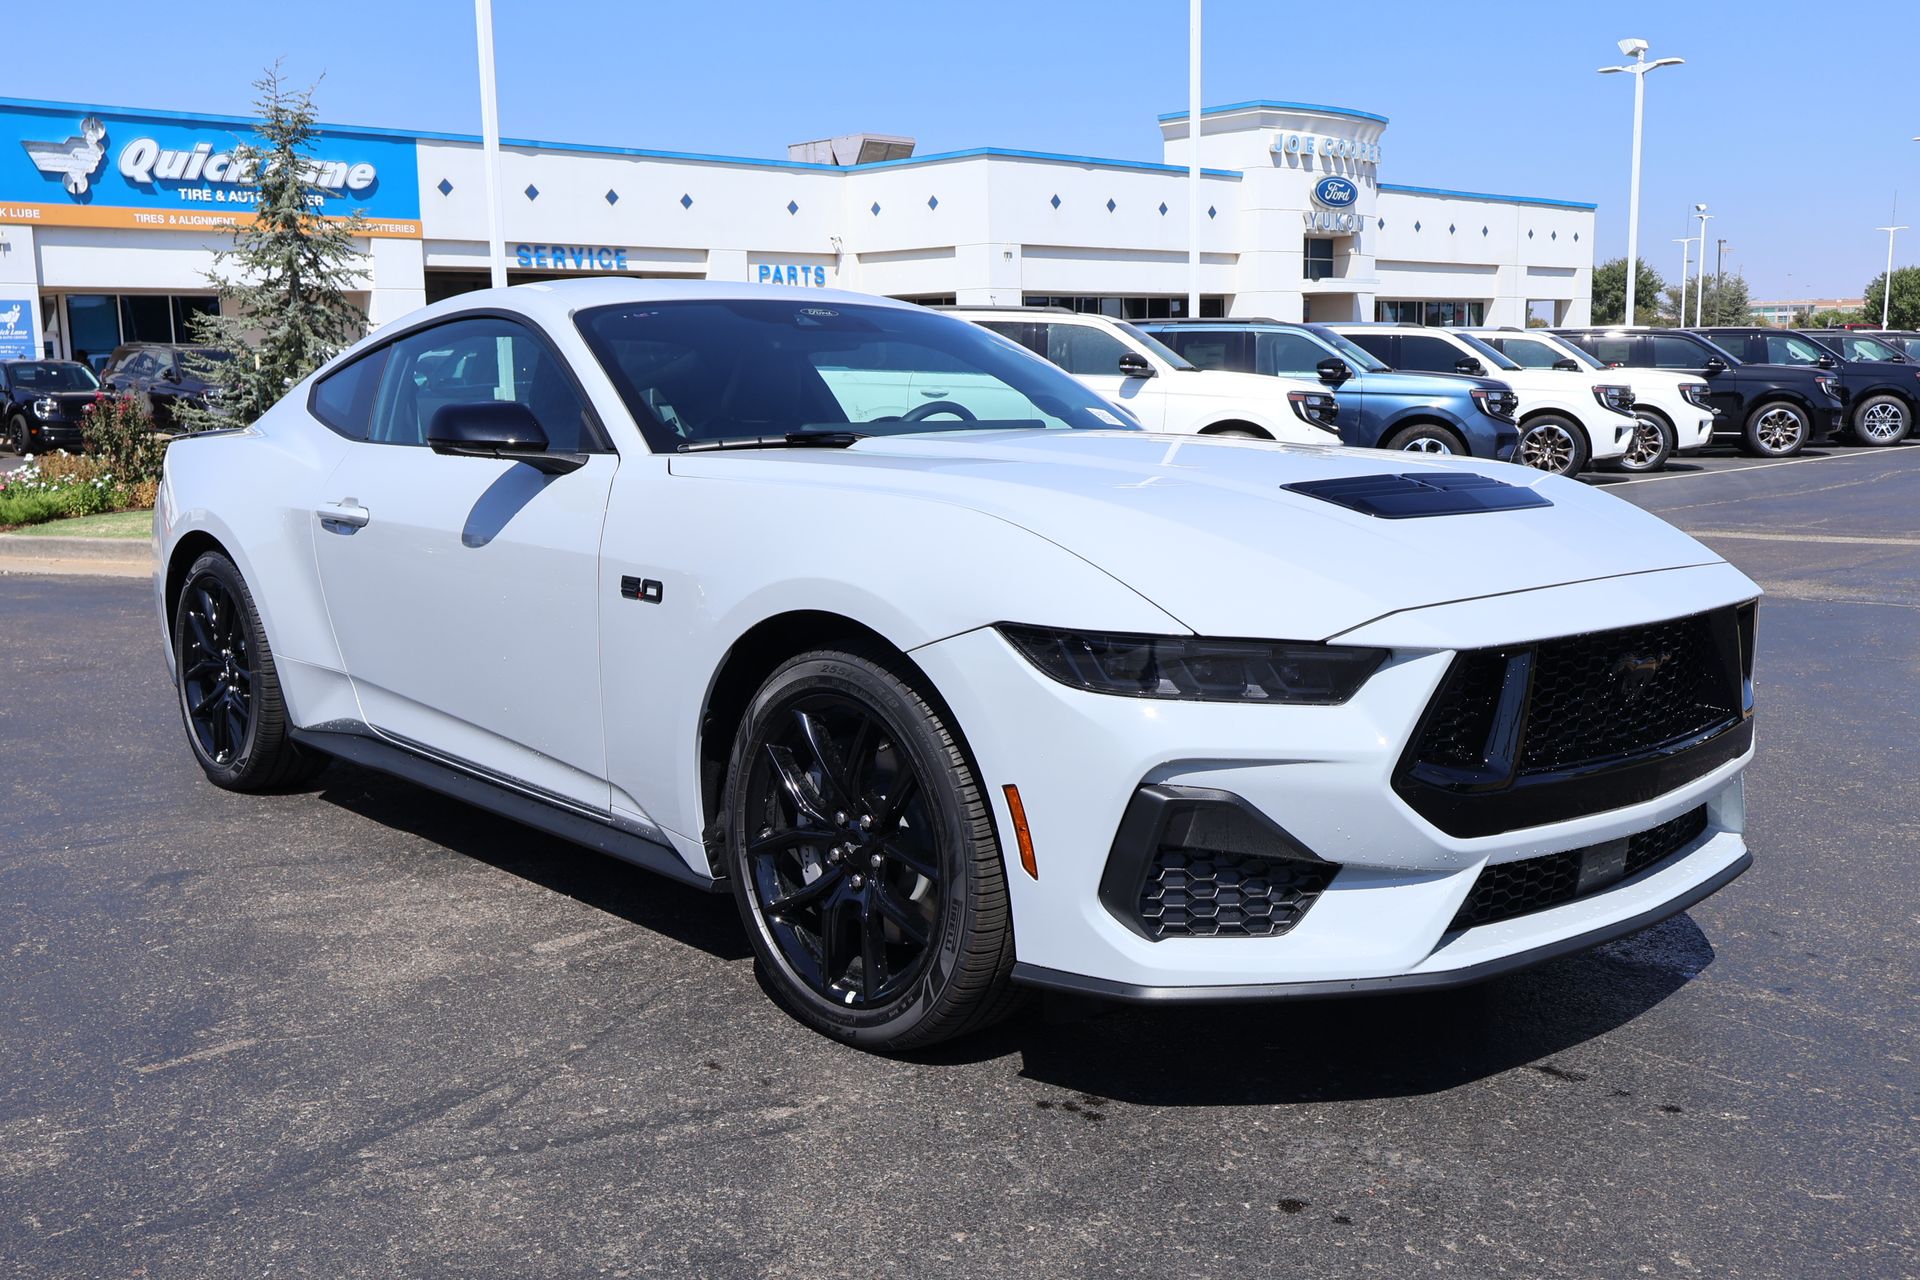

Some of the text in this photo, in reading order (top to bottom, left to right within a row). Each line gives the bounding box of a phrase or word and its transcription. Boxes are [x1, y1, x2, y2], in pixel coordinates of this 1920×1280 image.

[1270, 133, 1315, 155] JOE
[178, 188, 212, 202] TIRE
[216, 191, 226, 202] &
[1324, 181, 1351, 201] Ford
[10, 207, 41, 219] LUBE
[134, 213, 237, 226] TIRES & ALIGNMENT
[1304, 212, 1364, 232] YUKON
[516, 245, 628, 270] SERVICE
[758, 264, 826, 287] PARTS
[621, 575, 663, 605] 5.0
